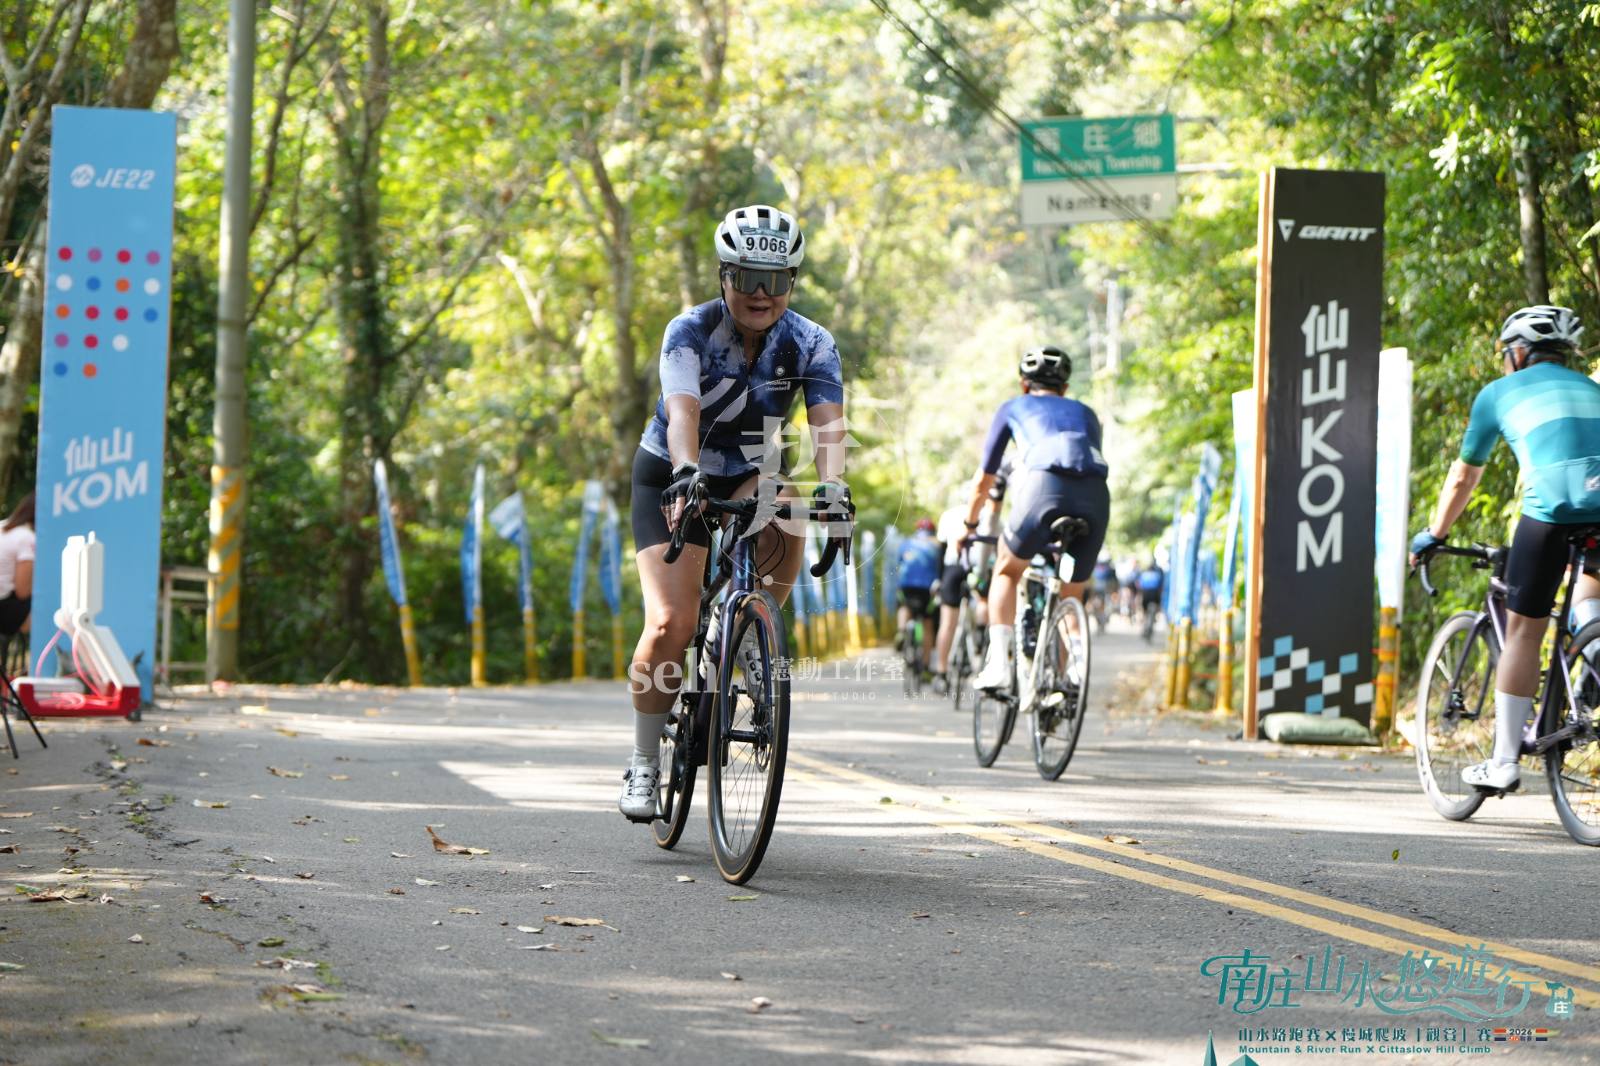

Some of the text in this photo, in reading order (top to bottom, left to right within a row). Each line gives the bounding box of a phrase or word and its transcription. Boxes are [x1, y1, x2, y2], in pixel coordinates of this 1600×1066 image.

[96, 168, 156, 190] JE22
[1298, 224, 1377, 242] GIANT
[64, 426, 134, 477] 仙山
[1296, 299, 1350, 573] 仙山 KOM
[52, 460, 150, 518] KOM
